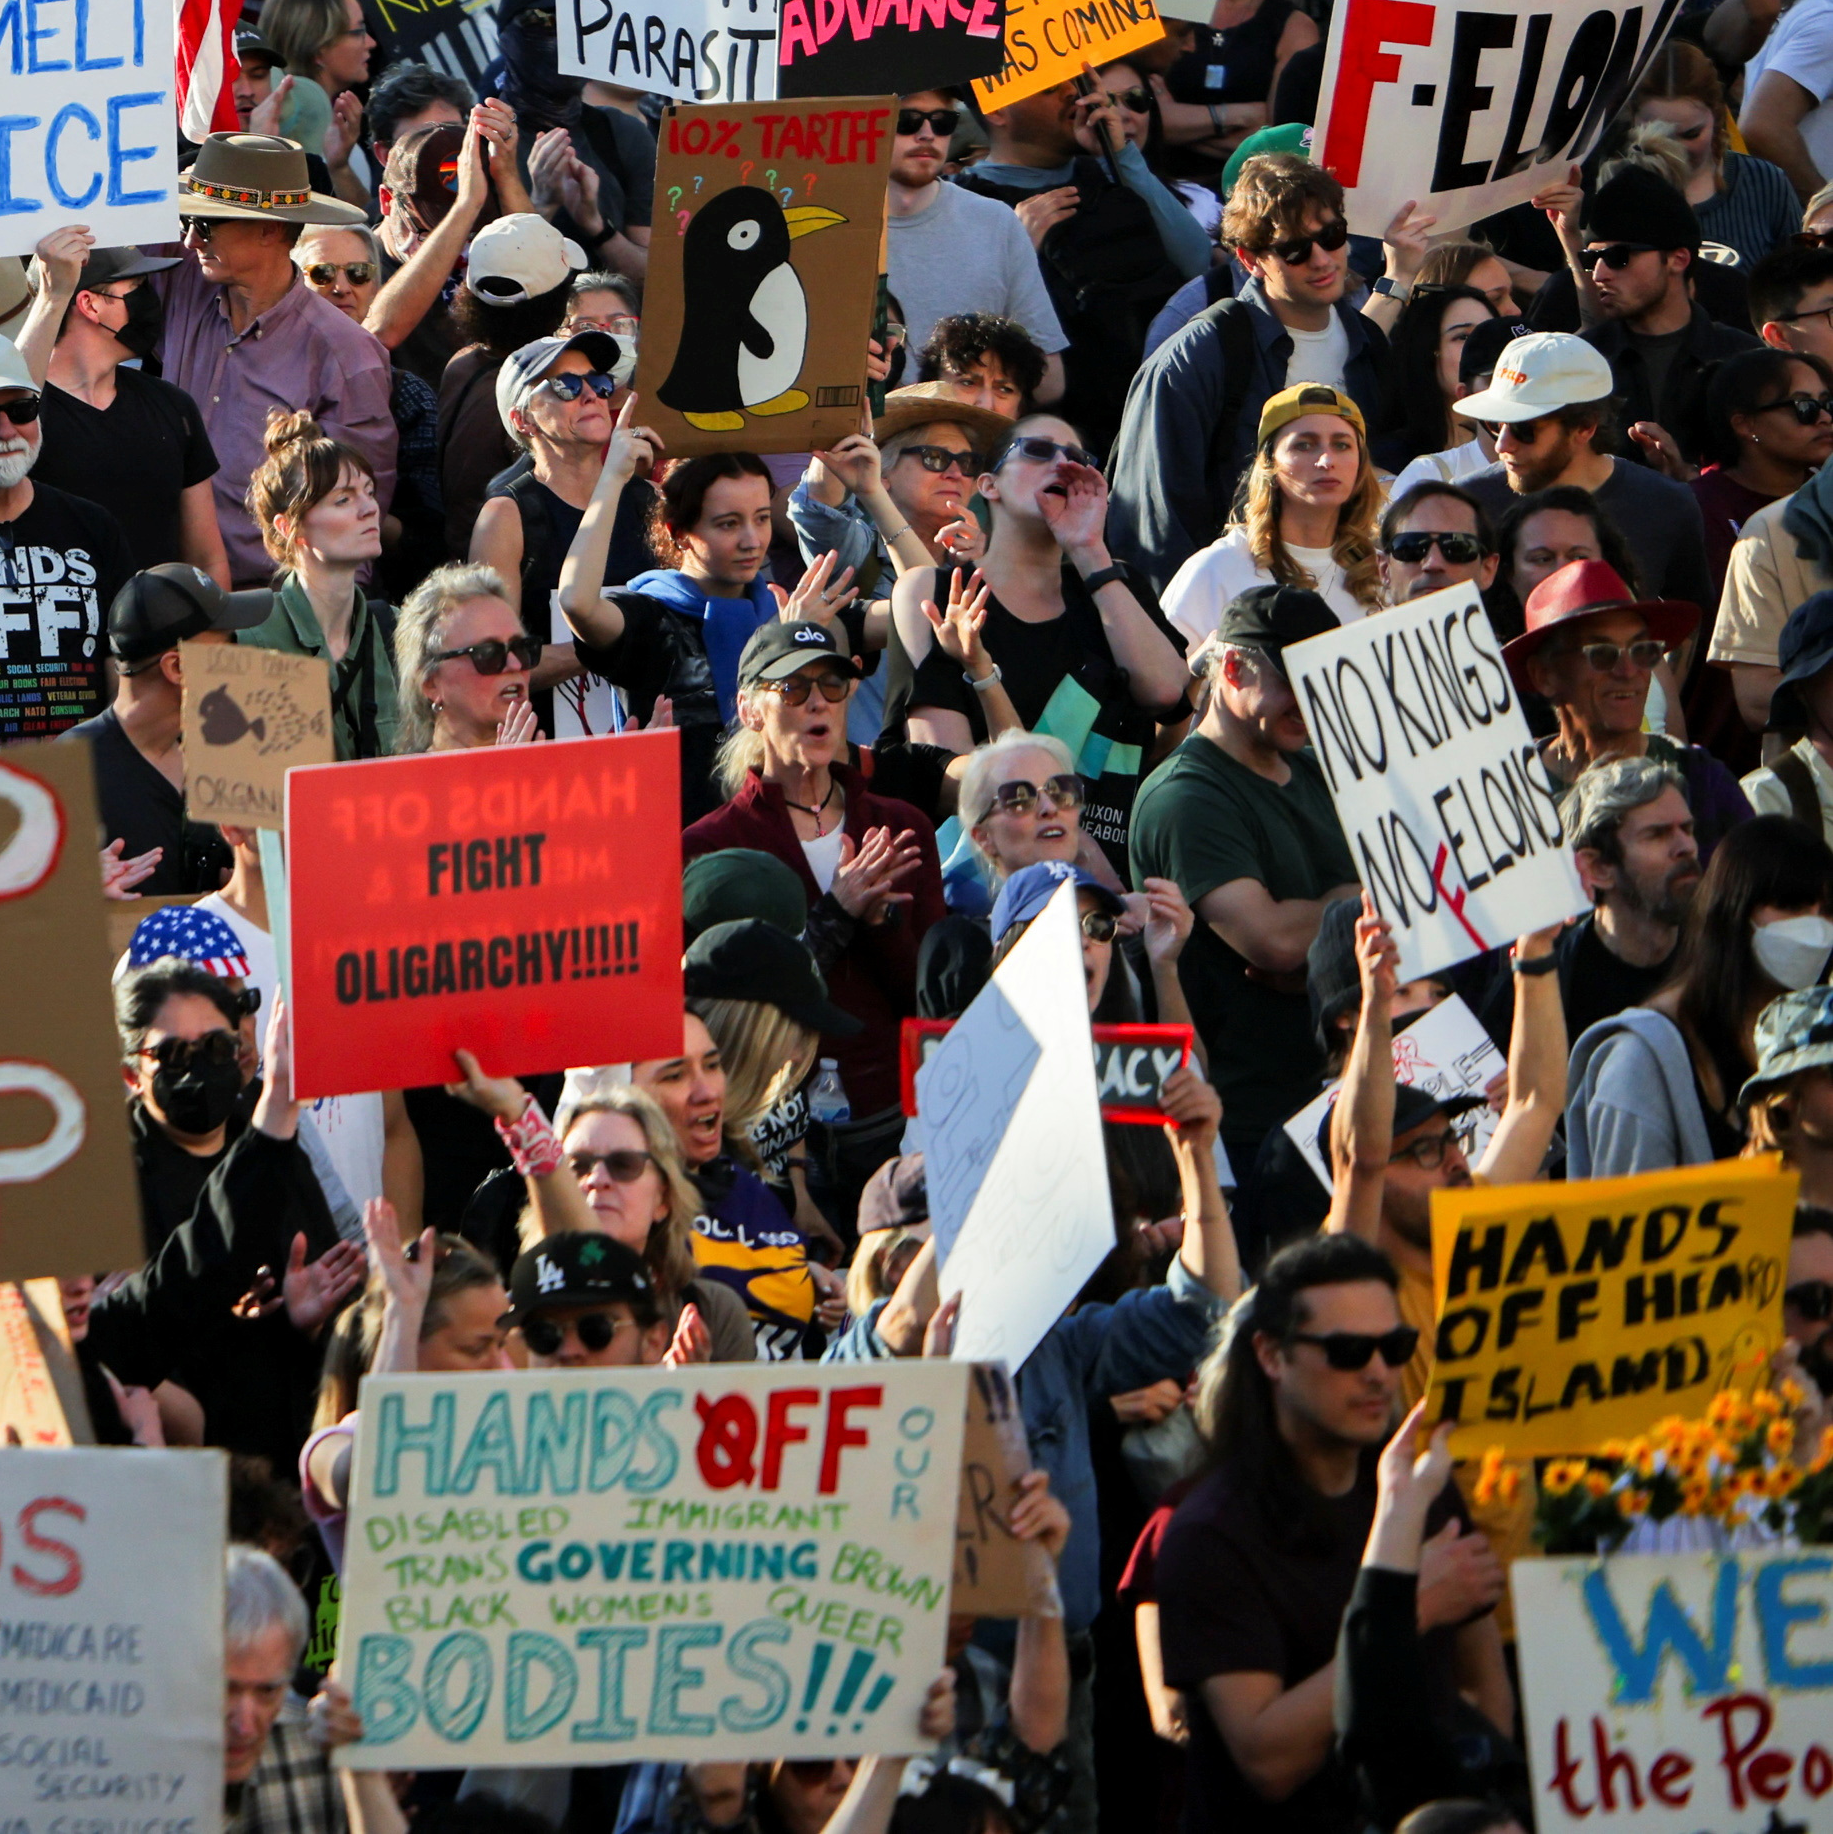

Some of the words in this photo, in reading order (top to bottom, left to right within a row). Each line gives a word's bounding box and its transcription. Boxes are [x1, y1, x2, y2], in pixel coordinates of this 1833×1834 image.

[667, 116, 732, 159] 10%
[741, 107, 891, 169] TARIFF
[6, 664, 33, 674] SOCIAL
[36, 663, 68, 673] SECURITY
[13, 678, 37, 689] BOOKS
[17, 692, 42, 703] LANDS
[1301, 657, 1389, 792] NO
[1369, 602, 1511, 761] KINGS
[426, 832, 546, 898] FIGHT
[333, 920, 641, 1007] OLIGARCHY!!!!!
[1445, 1198, 1746, 1299] HANDS
[1434, 1280, 1600, 1363] OFF
[1432, 1334, 1711, 1427] ISLAND
[372, 1388, 683, 1498] HANDS
[692, 1384, 885, 1496] OFF
[516, 1539, 818, 1585] GOVERNING
[354, 1620, 897, 1746] BODIES!!!
[35, 1771, 187, 1805] SECURITY
